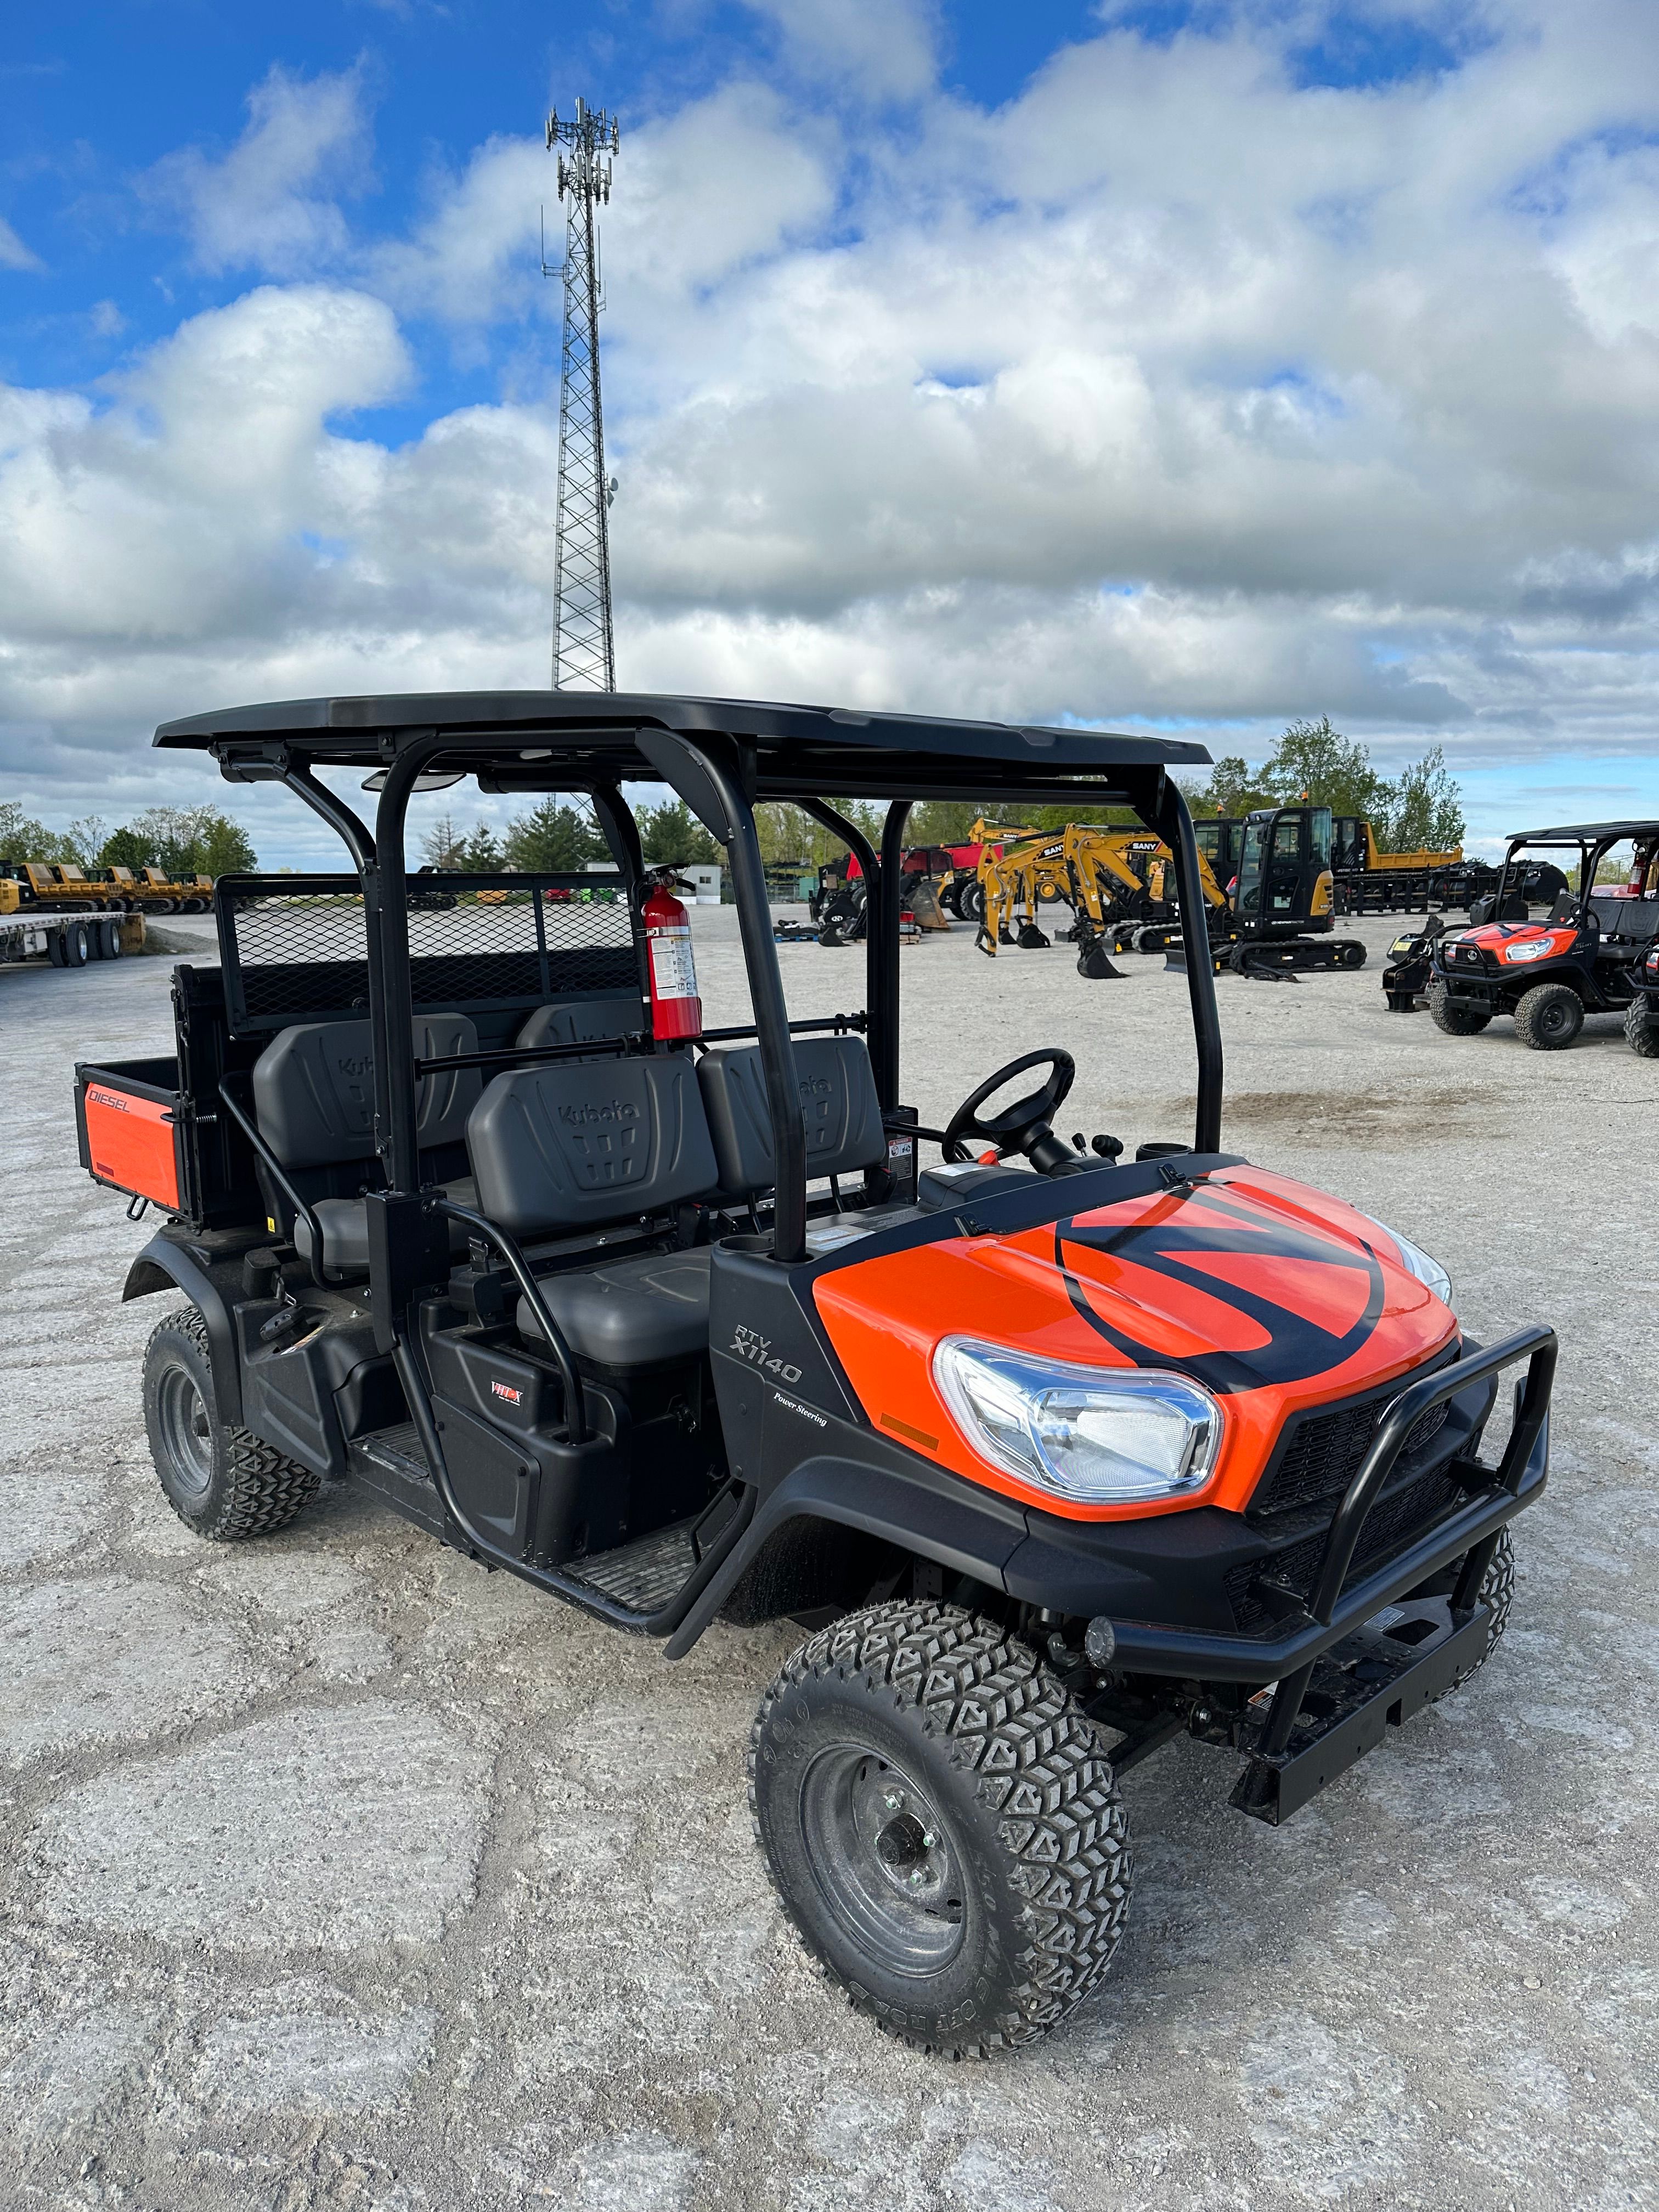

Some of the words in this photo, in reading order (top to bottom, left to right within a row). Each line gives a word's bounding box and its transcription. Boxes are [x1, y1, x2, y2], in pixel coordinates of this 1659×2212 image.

[338, 1056, 374, 1077] Kub
[799, 1075, 832, 1095] ota
[88, 1090, 130, 1113] DIESEL
[557, 1099, 640, 1127] Kubota
[735, 1324, 772, 1349] RTV
[729, 1335, 803, 1383] X1140
[773, 1392, 797, 1409] Power
[795, 1404, 828, 1427] Steering
[849, 1980, 927, 2032] ROAD
